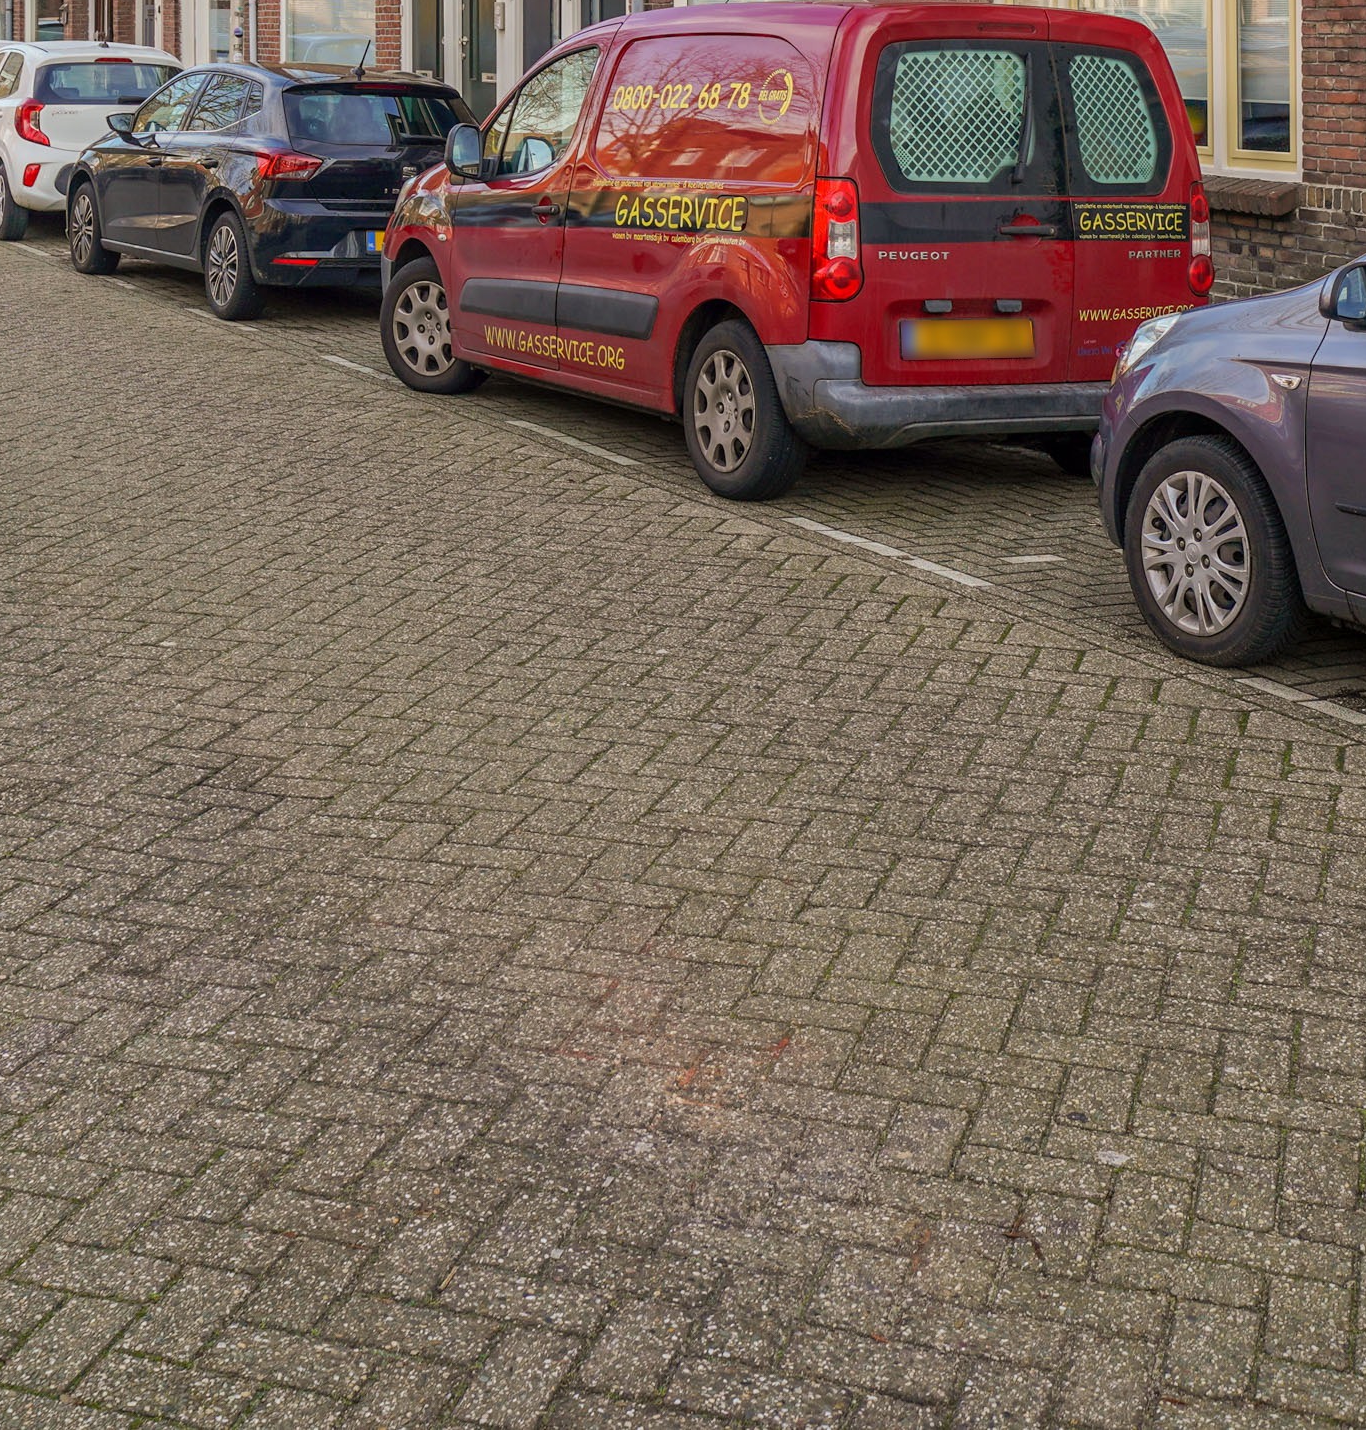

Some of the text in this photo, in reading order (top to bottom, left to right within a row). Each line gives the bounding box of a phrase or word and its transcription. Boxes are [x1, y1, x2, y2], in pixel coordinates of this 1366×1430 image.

[613, 82, 751, 110] 0800-022 68 78
[615, 194, 746, 231] GASSERVICE
[1079, 212, 1183, 231] GASSERVICE
[878, 251, 950, 260] PEUGEOT
[1128, 250, 1181, 259] PARTNER
[1079, 304, 1194, 321] WWW.GASSERVICEOR
[484, 324, 626, 370] WWW.GASSERVICE.ORG
